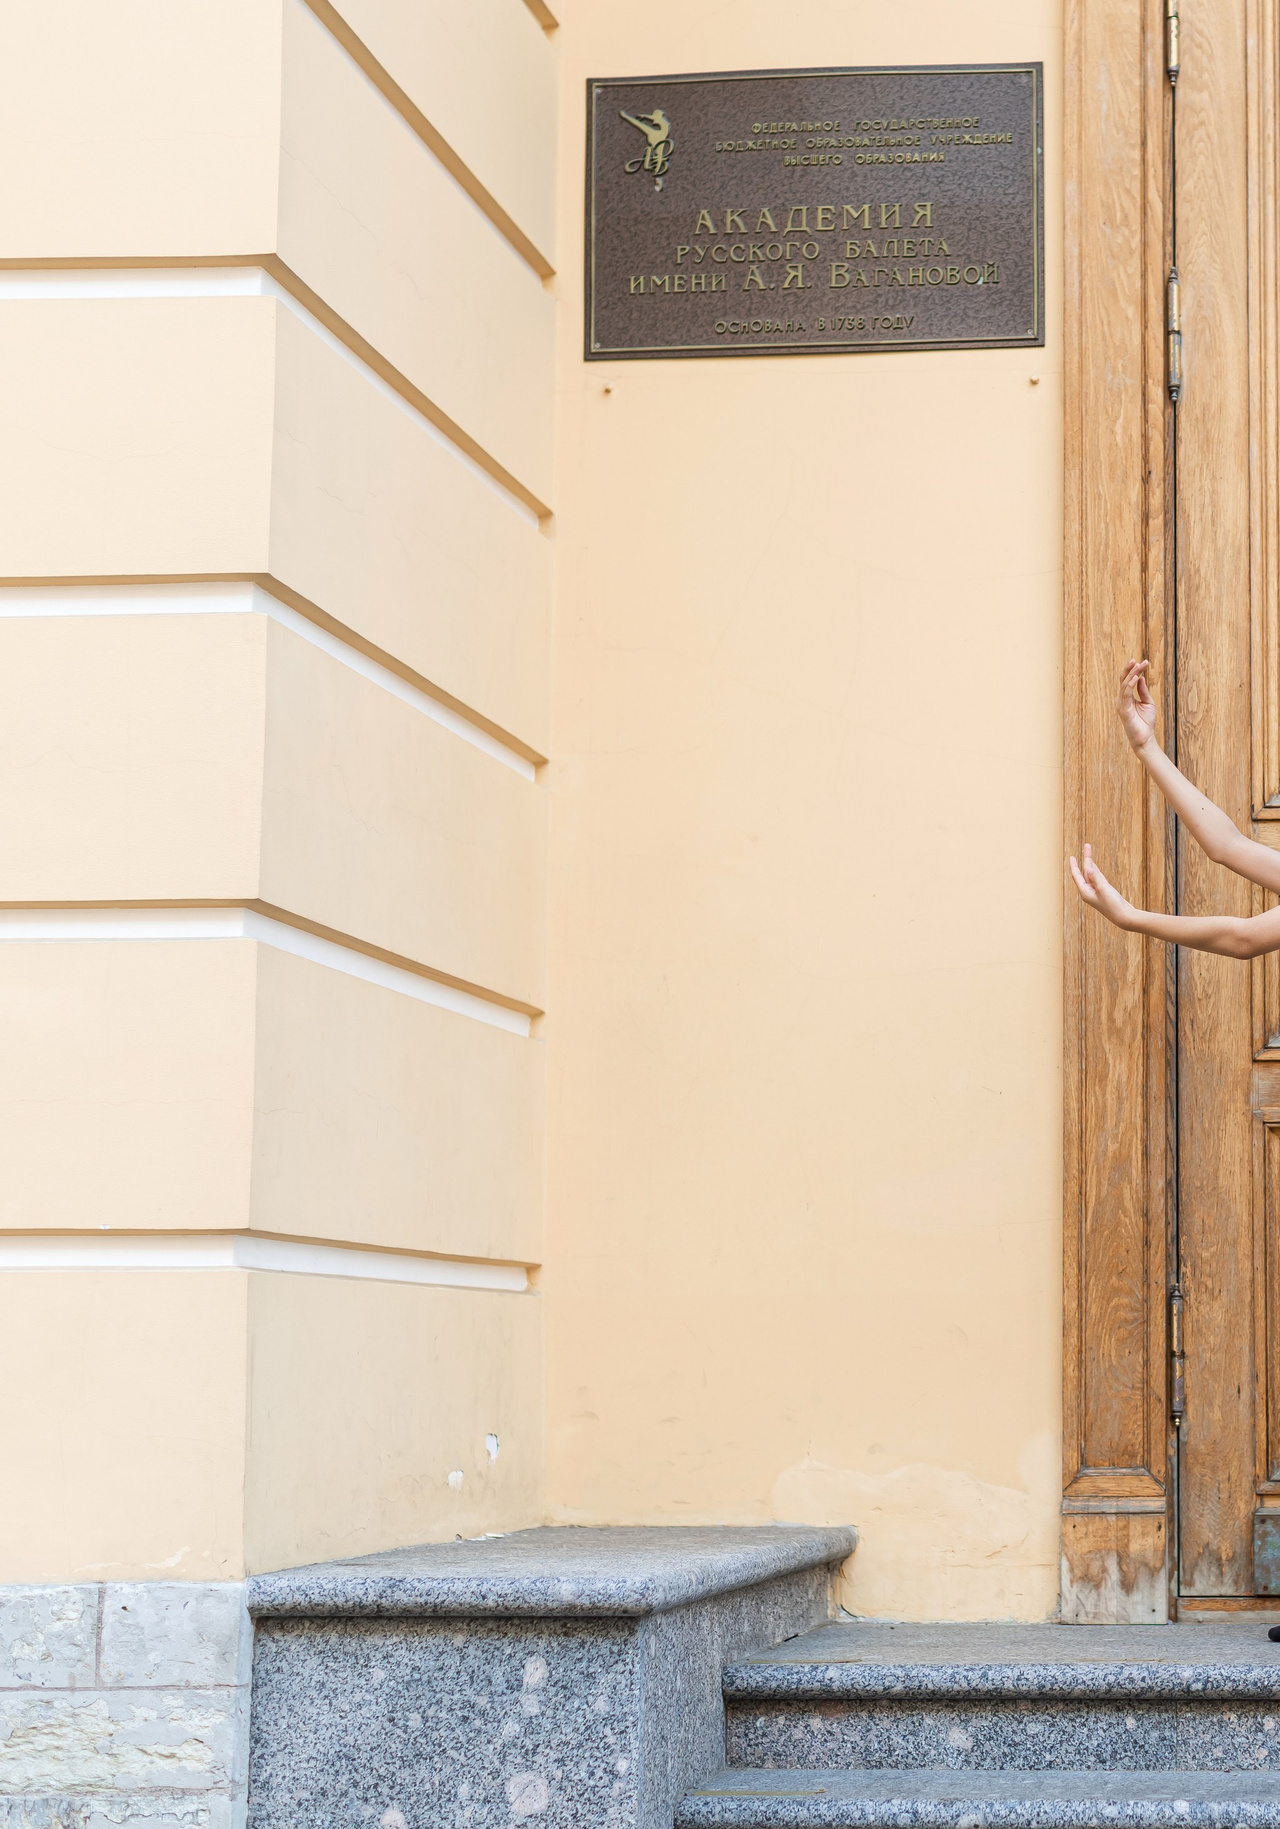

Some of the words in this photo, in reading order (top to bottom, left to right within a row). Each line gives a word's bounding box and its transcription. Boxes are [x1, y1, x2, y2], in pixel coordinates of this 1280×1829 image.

[751, 120, 841, 135] ФЕДЕРАЛЬНОЕ
[852, 116, 980, 132] ГОСУДАРСТВЕННОЕ
[715, 138, 798, 152] БЮДЖЕТНОЕ
[805, 135, 922, 149] ОБРАЗОВАТЕЛЬНОЕ
[930, 132, 1013, 146] УЧРЕЖДЕНИЕ
[783, 154, 843, 167] ВЫСШЕГО
[854, 151, 945, 165] ОБРАЗОВАНИЯ
[694, 202, 934, 237] АКАДЕМИЯ
[675, 241, 820, 264] РУССКОГО
[845, 237, 951, 259] БАЛЕТА
[629, 272, 728, 295] ИМЕНИ
[713, 318, 807, 335] ОСНОВАНА
[816, 317, 826, 331] В
[830, 316, 866, 331] 1738
[870, 314, 915, 330] ГОДУ
